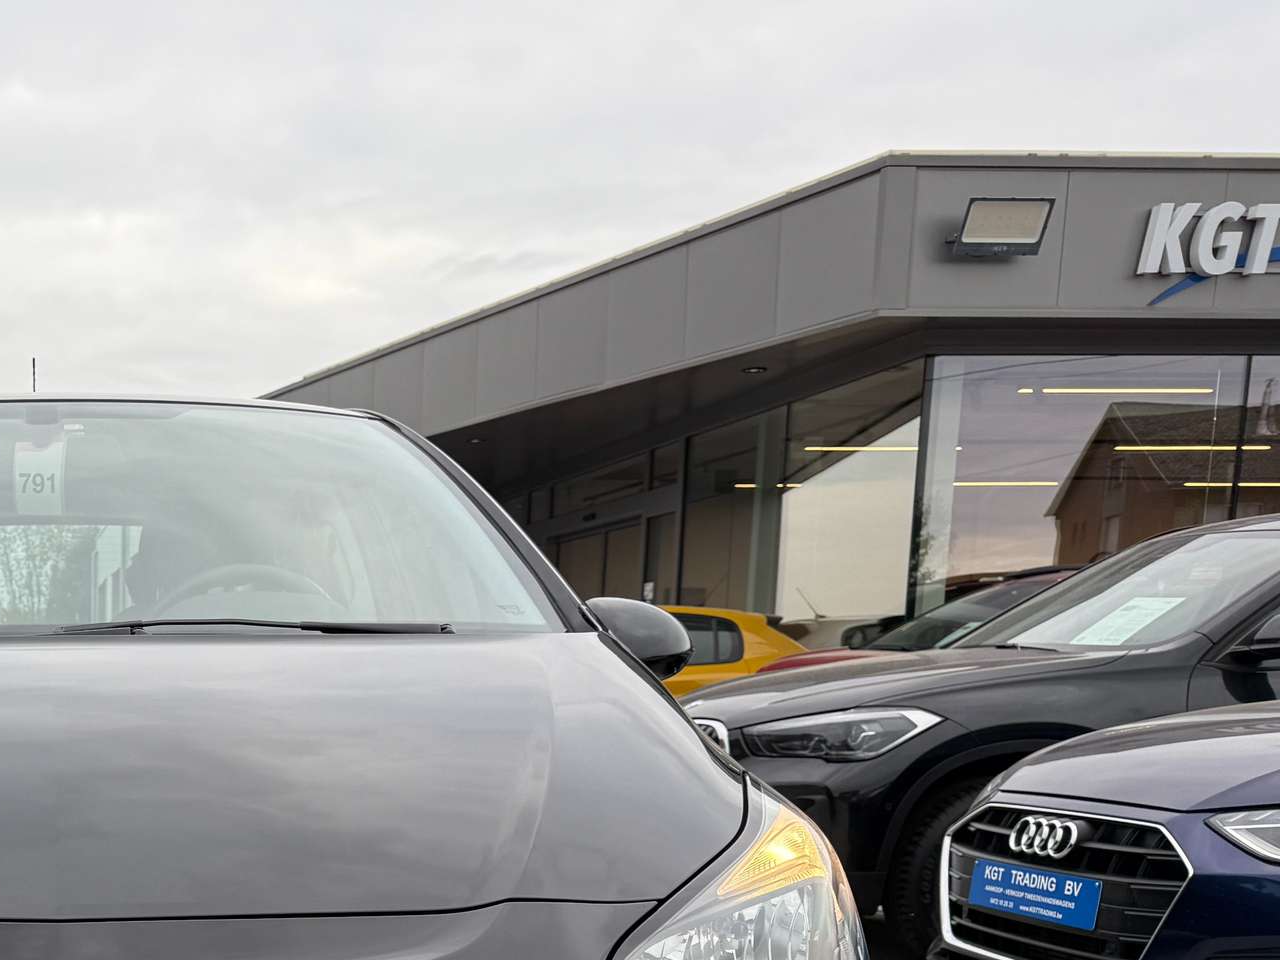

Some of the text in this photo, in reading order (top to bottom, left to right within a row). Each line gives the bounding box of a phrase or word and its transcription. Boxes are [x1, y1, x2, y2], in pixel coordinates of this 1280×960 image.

[1136, 201, 1280, 277] KGT
[18, 473, 56, 494] 791
[984, 865, 1083, 897] KGT TRADING BV
